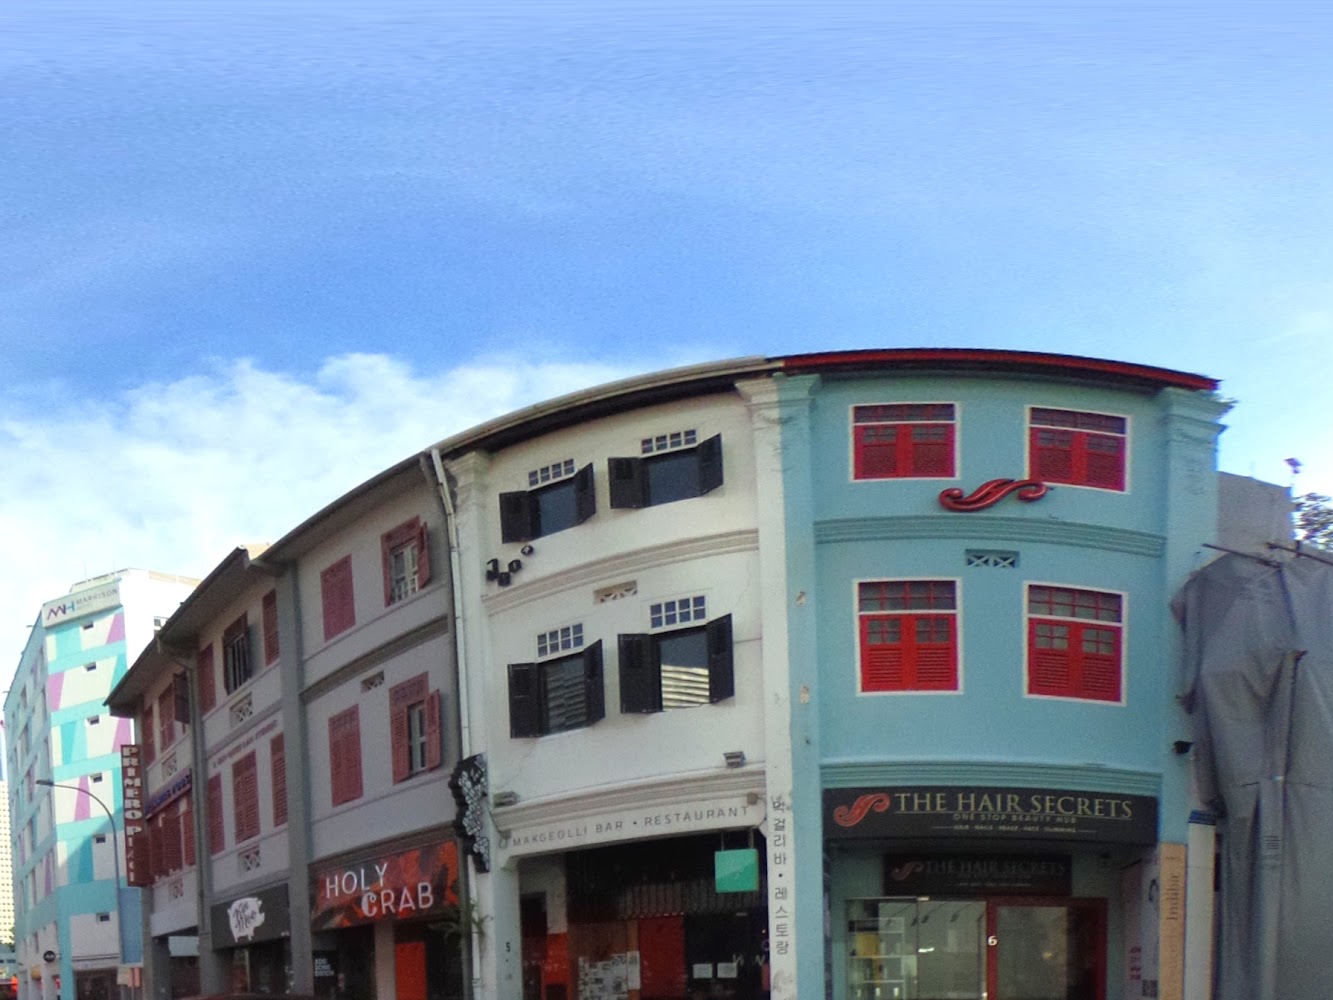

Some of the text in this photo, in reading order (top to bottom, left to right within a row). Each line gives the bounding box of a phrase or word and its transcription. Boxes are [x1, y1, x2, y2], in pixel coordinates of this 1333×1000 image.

[122, 746, 143, 820] PRIMERO
[895, 793, 1133, 818] THE HAIR SECRETS
[953, 813, 974, 821] ONE
[981, 813, 1006, 821] STOP
[512, 804, 750, 848] MAKGEOLLI BAR RESTAURANT
[326, 863, 388, 899] HOLY
[361, 882, 433, 917] CRAB
[774, 886, 790, 955] 레스토랑
[505, 942, 511, 953] 5
[988, 935, 998, 945] 6
